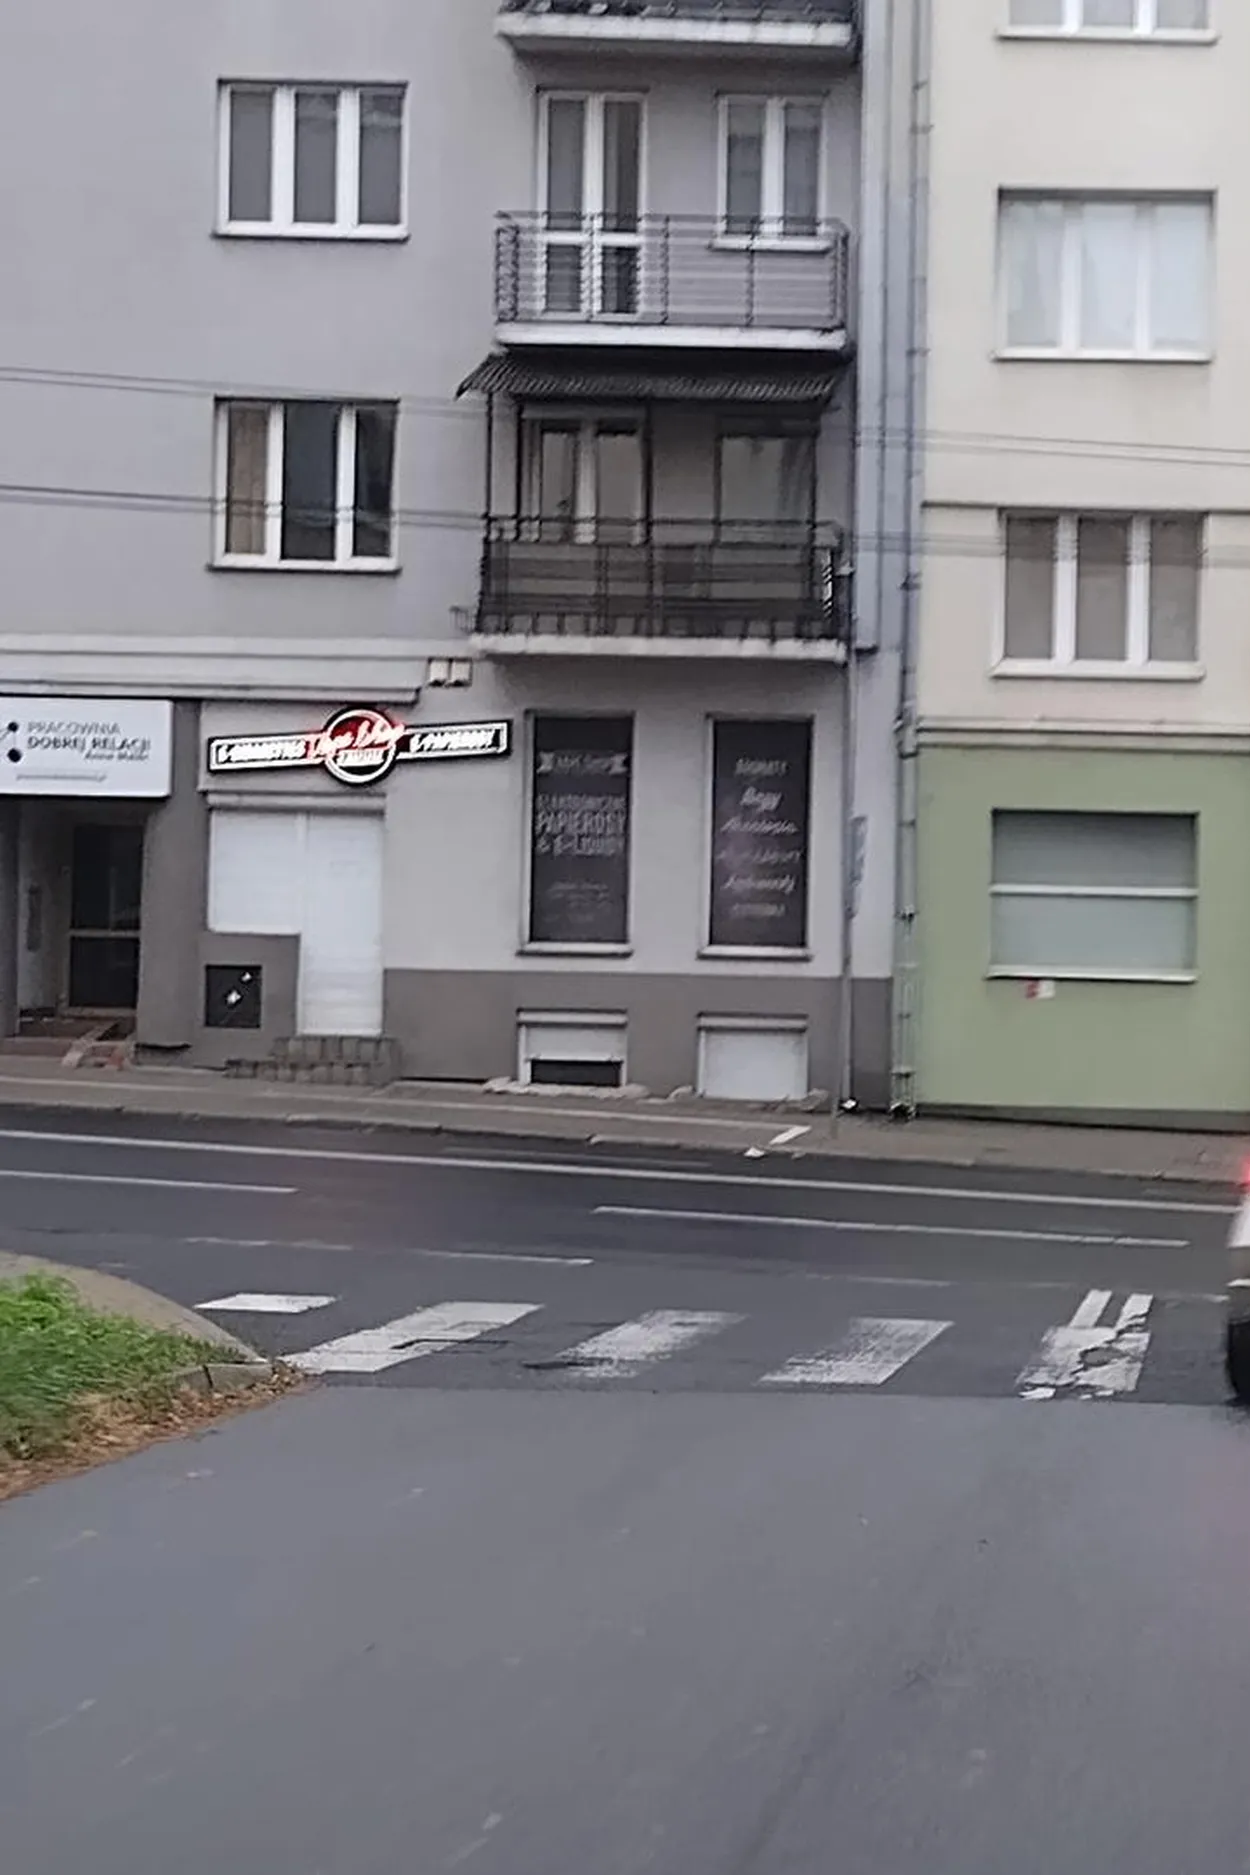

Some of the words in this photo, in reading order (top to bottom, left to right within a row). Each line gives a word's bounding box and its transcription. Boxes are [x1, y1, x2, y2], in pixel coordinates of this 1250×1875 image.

[27, 721, 121, 735] PRACOWNIA
[27, 736, 87, 751] DOBREJ
[91, 737, 151, 752] RELACJI
